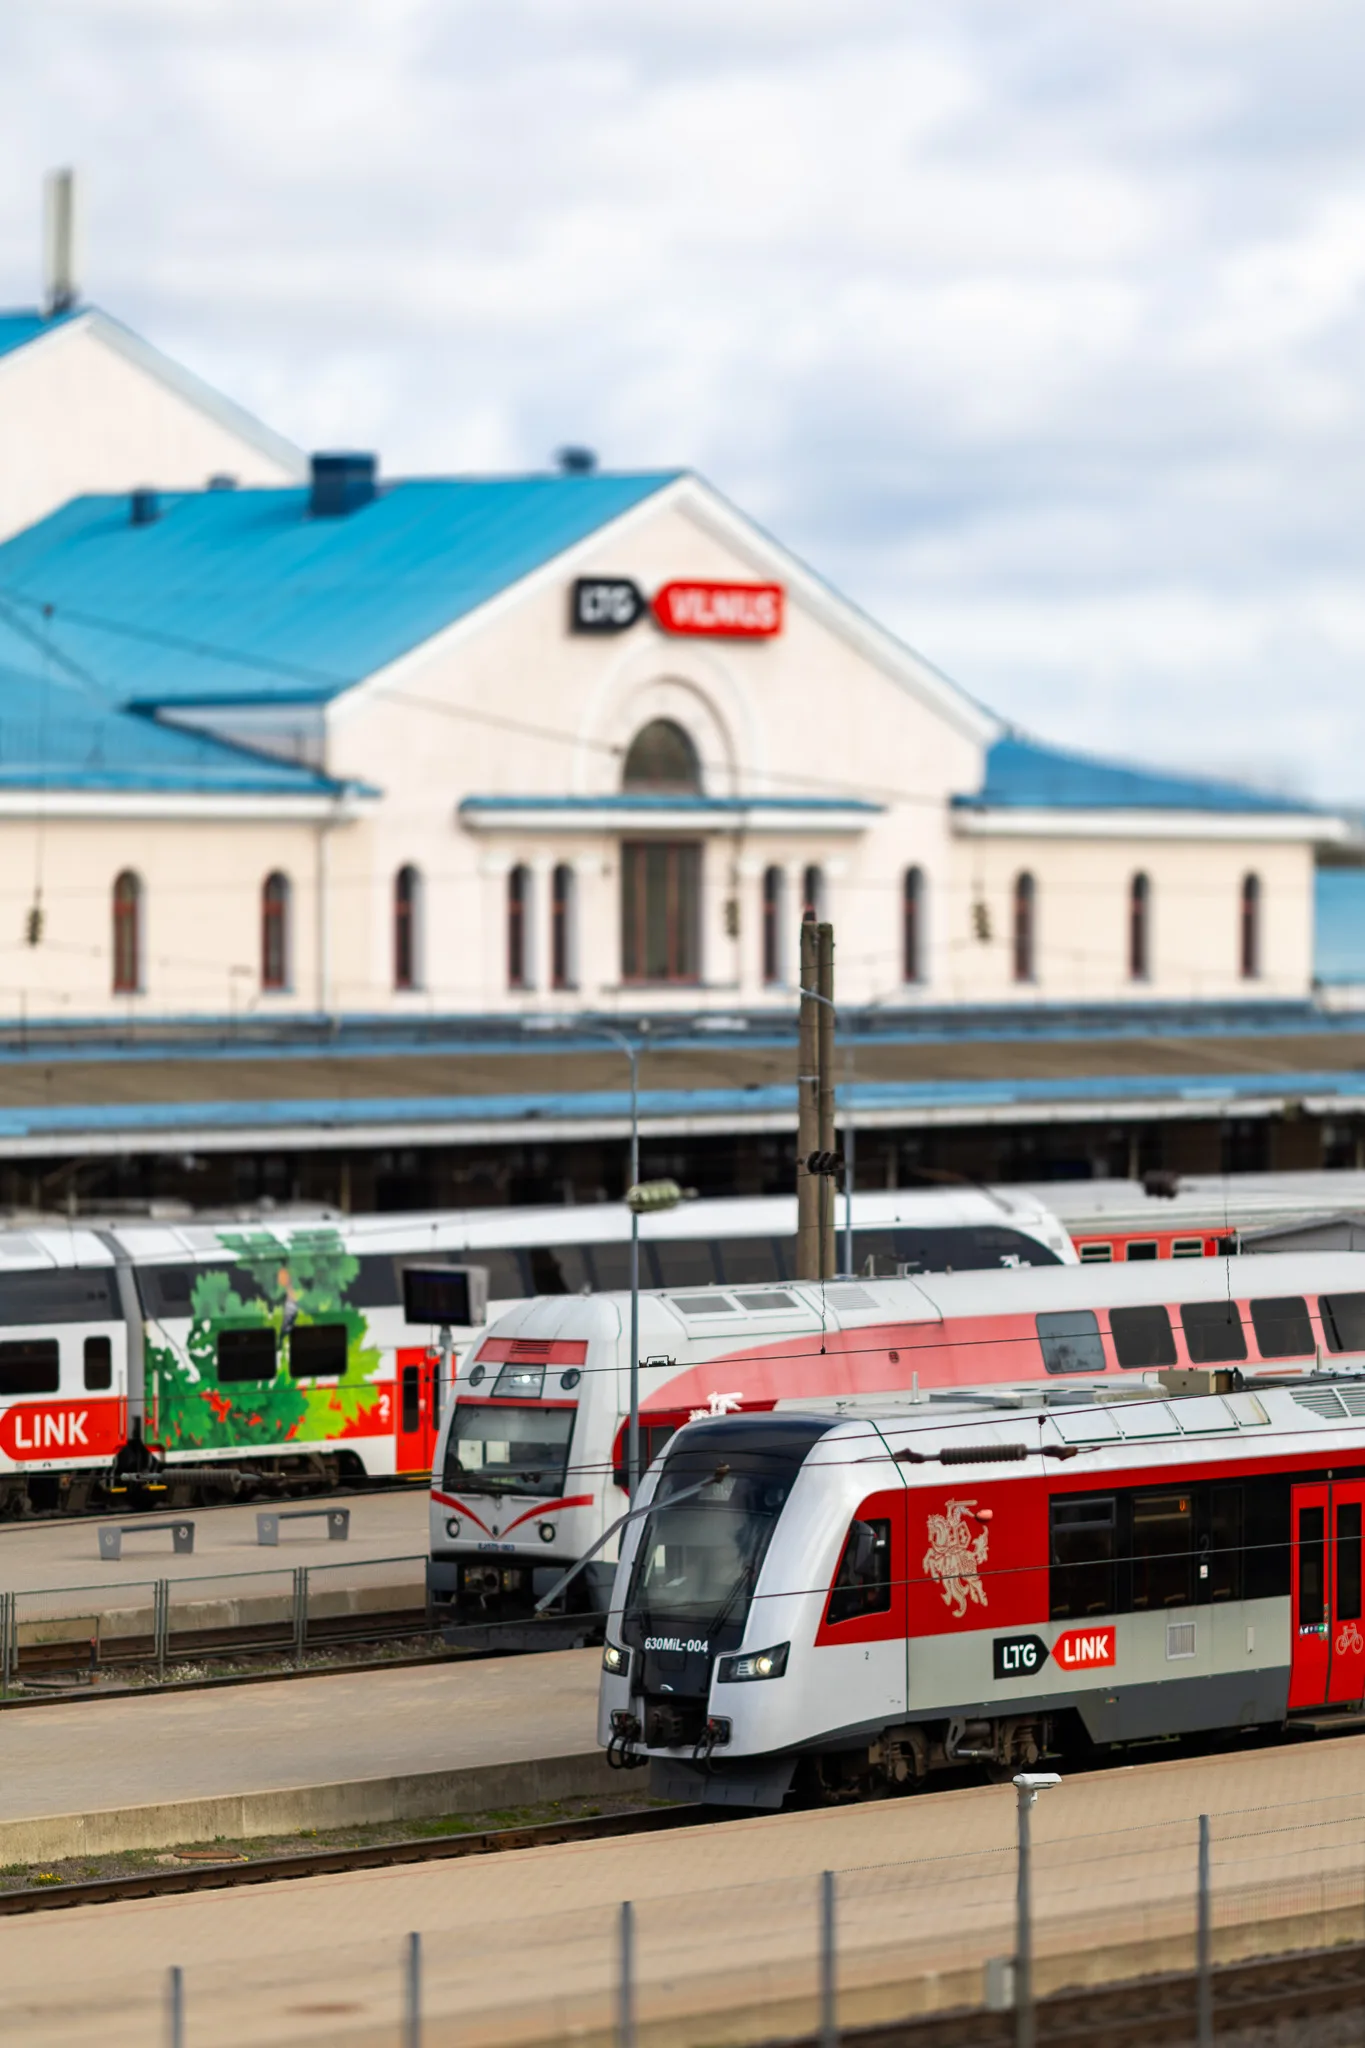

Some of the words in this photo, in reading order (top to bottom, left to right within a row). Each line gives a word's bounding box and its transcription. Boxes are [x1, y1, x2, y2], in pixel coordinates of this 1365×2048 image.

[580, 586, 635, 623] LTG
[668, 587, 776, 628] VILNIUS
[15, 1410, 88, 1448] LINK
[644, 1637, 709, 1653] 630MiL-004
[1003, 1643, 1037, 1669] LTG
[1064, 1635, 1109, 1662] LINK
